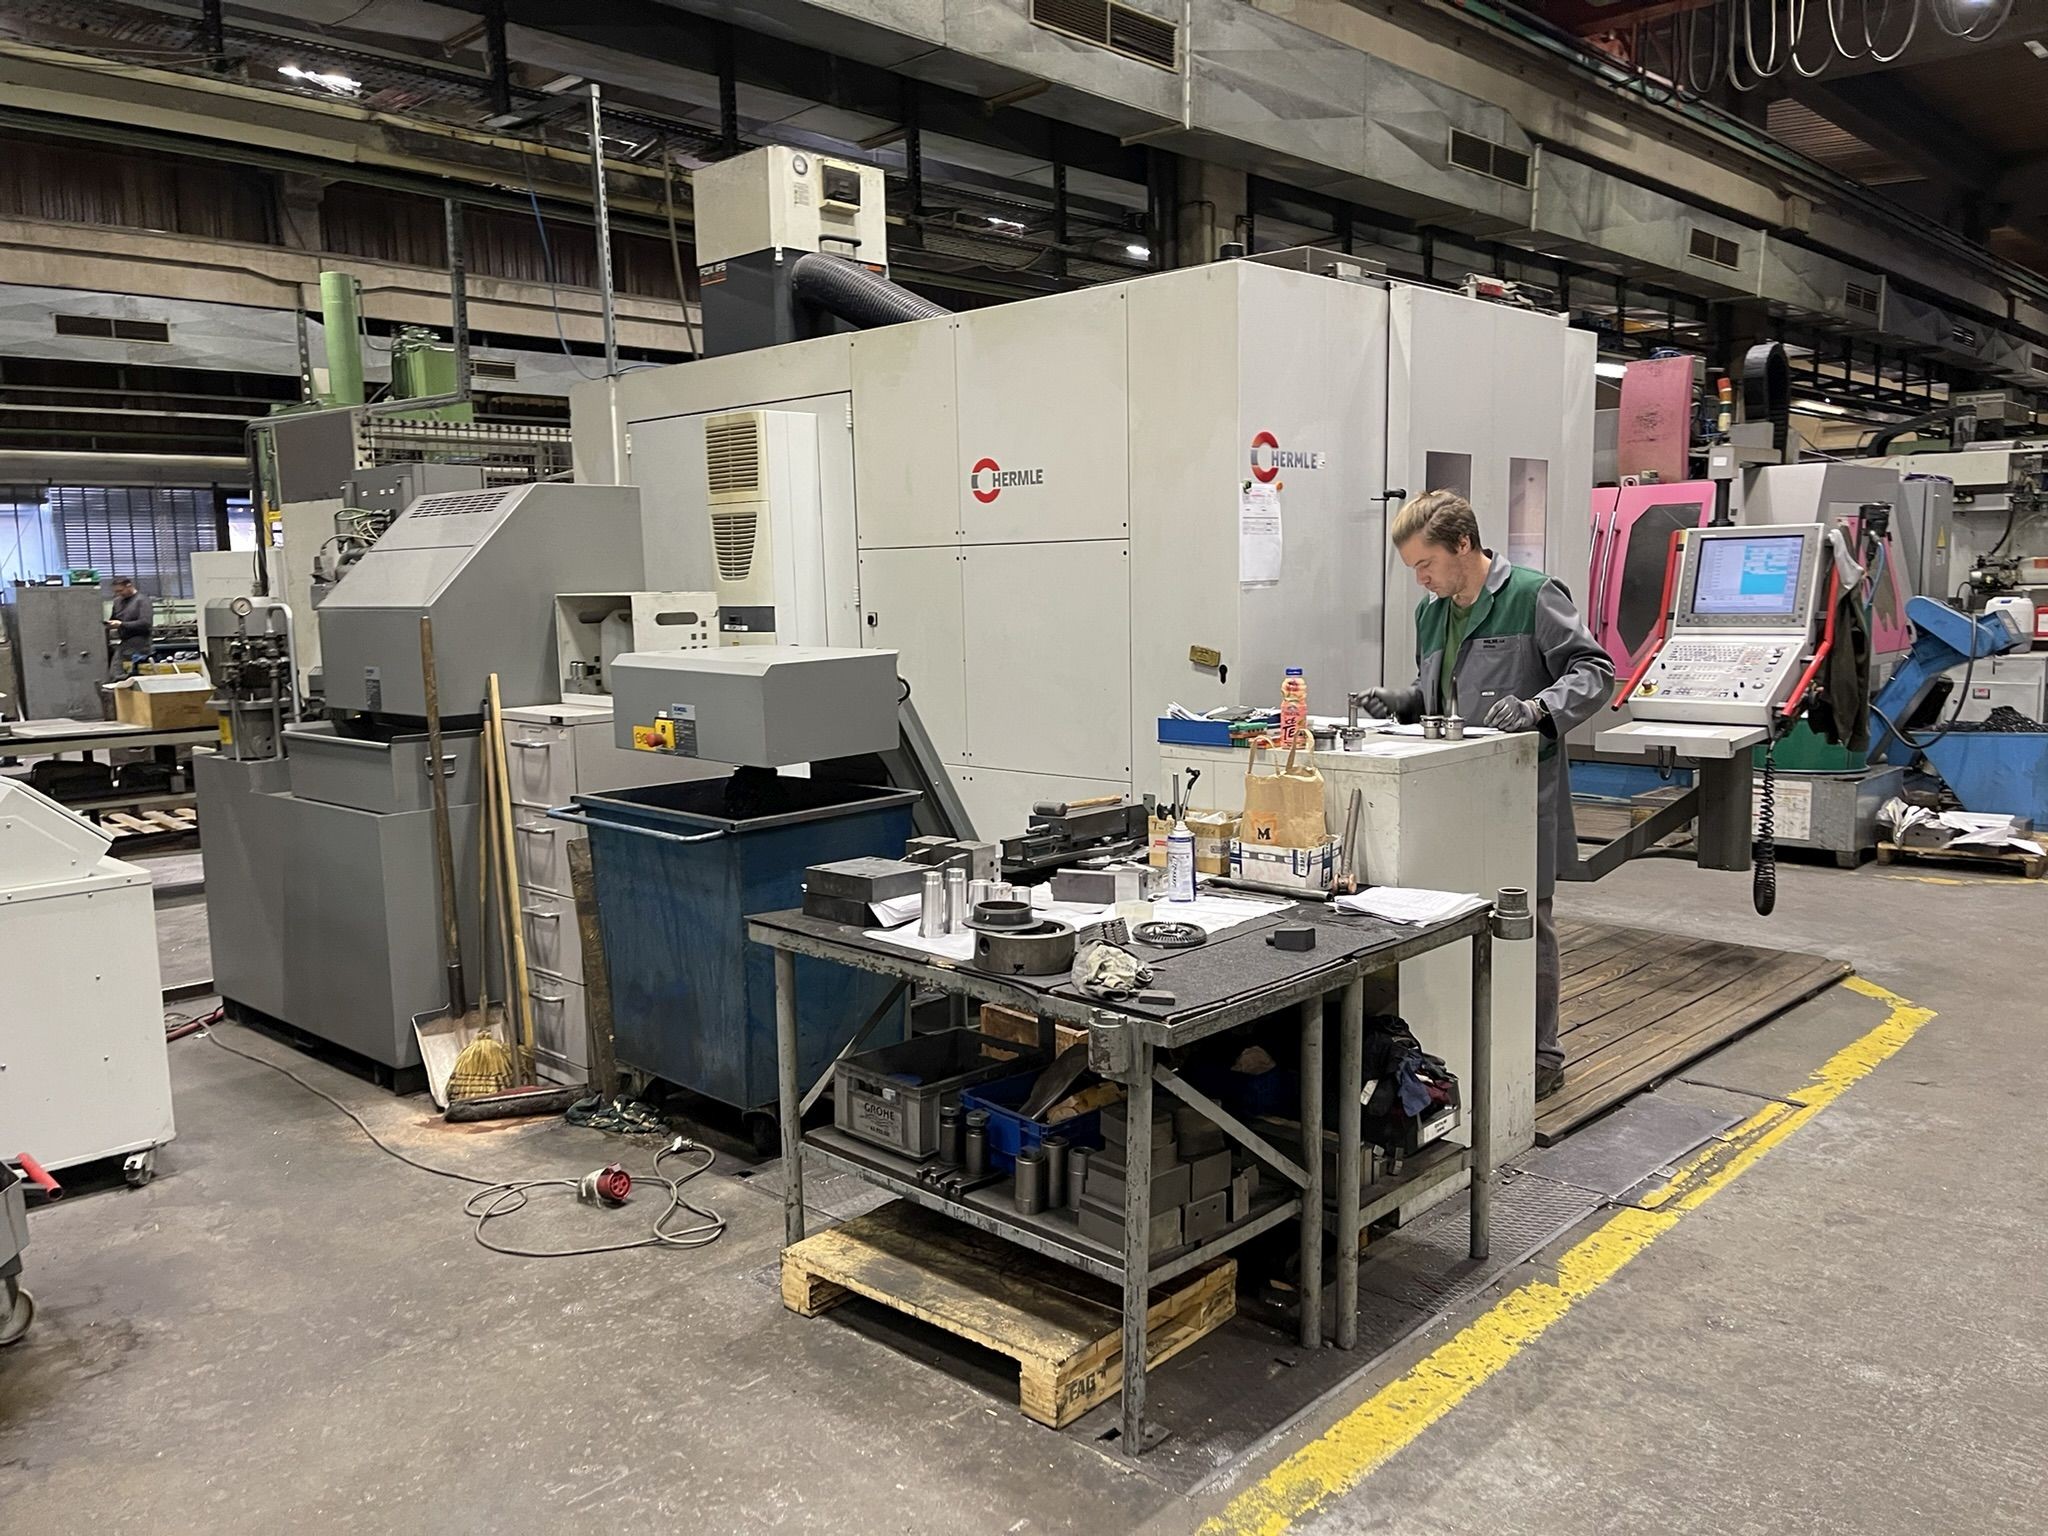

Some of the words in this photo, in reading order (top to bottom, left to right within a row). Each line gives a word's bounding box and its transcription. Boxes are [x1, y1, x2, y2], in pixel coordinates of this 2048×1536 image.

[1271, 450, 1317, 469] HERMLE
[992, 469, 1044, 487] HERMLE
[1283, 725, 1299, 741] TE
[1257, 827, 1271, 840] M
[864, 1102, 895, 1121] GROHE
